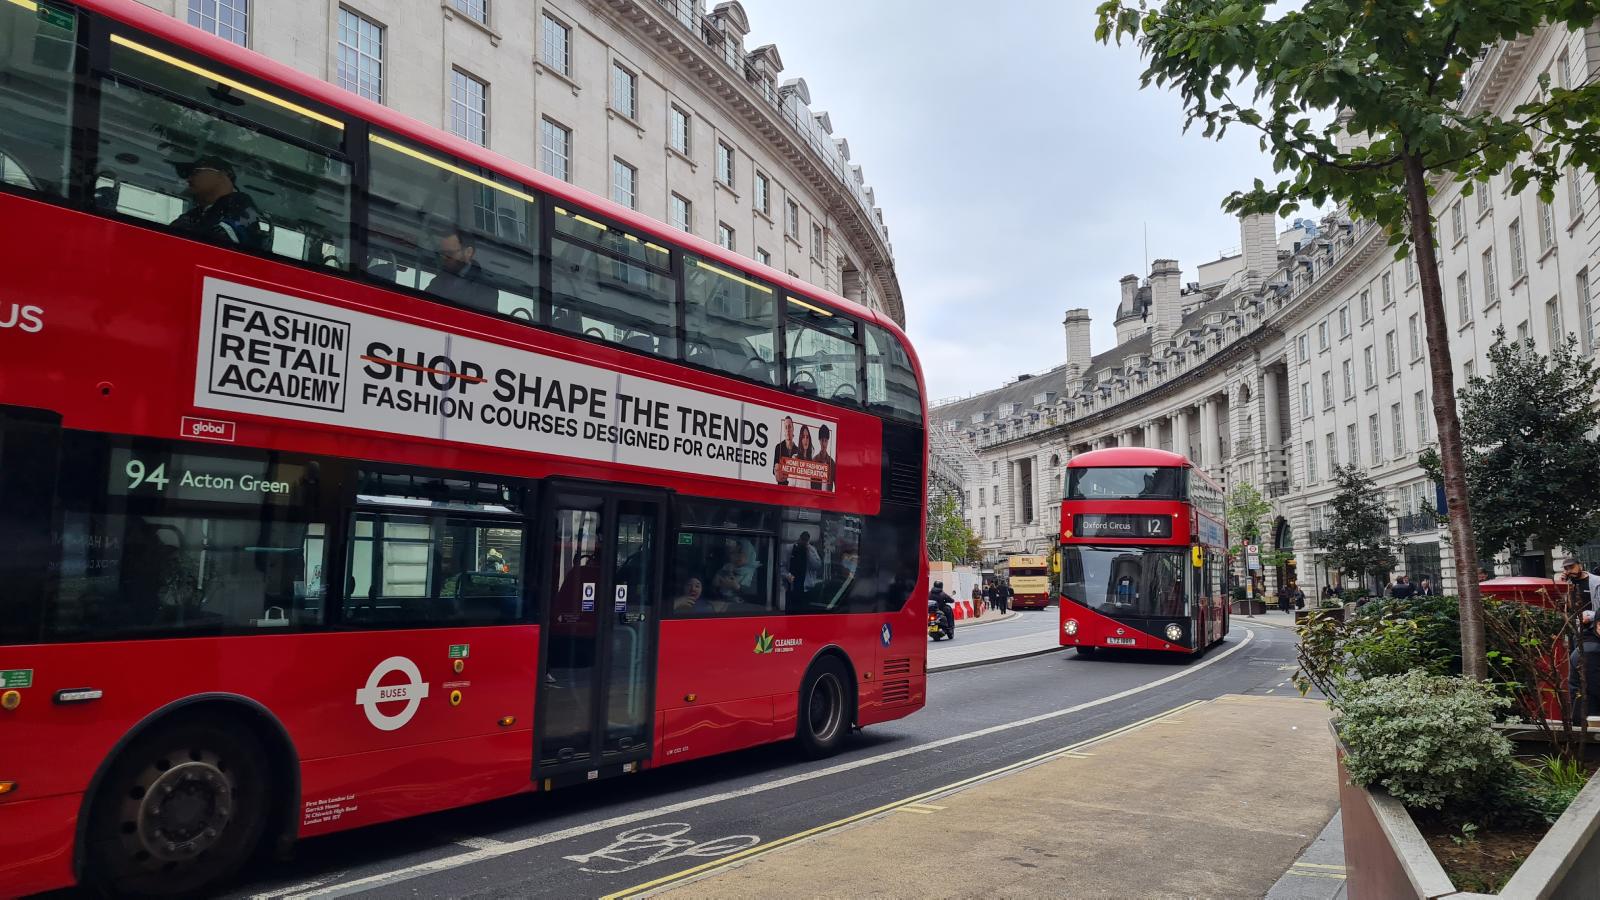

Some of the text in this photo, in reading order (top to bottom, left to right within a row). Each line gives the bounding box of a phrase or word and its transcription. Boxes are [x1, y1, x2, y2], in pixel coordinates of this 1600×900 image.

[222, 303, 343, 351] FASHION
[220, 333, 340, 378] RETAIL
[217, 363, 340, 404] ACADEMY
[362, 342, 769, 448] SHOP SHAPE THE TRENDS
[192, 421, 225, 435] global
[362, 383, 767, 467] FASHION COURSES DESIGNED FOR CAREERS
[126, 459, 289, 494] 94 Acton Green
[782, 465, 796, 473] NEXT
[796, 467, 828, 480] GENERATION
[1083, 519, 1161, 533] Oxford Circus 12
[380, 688, 407, 699] BUSES
